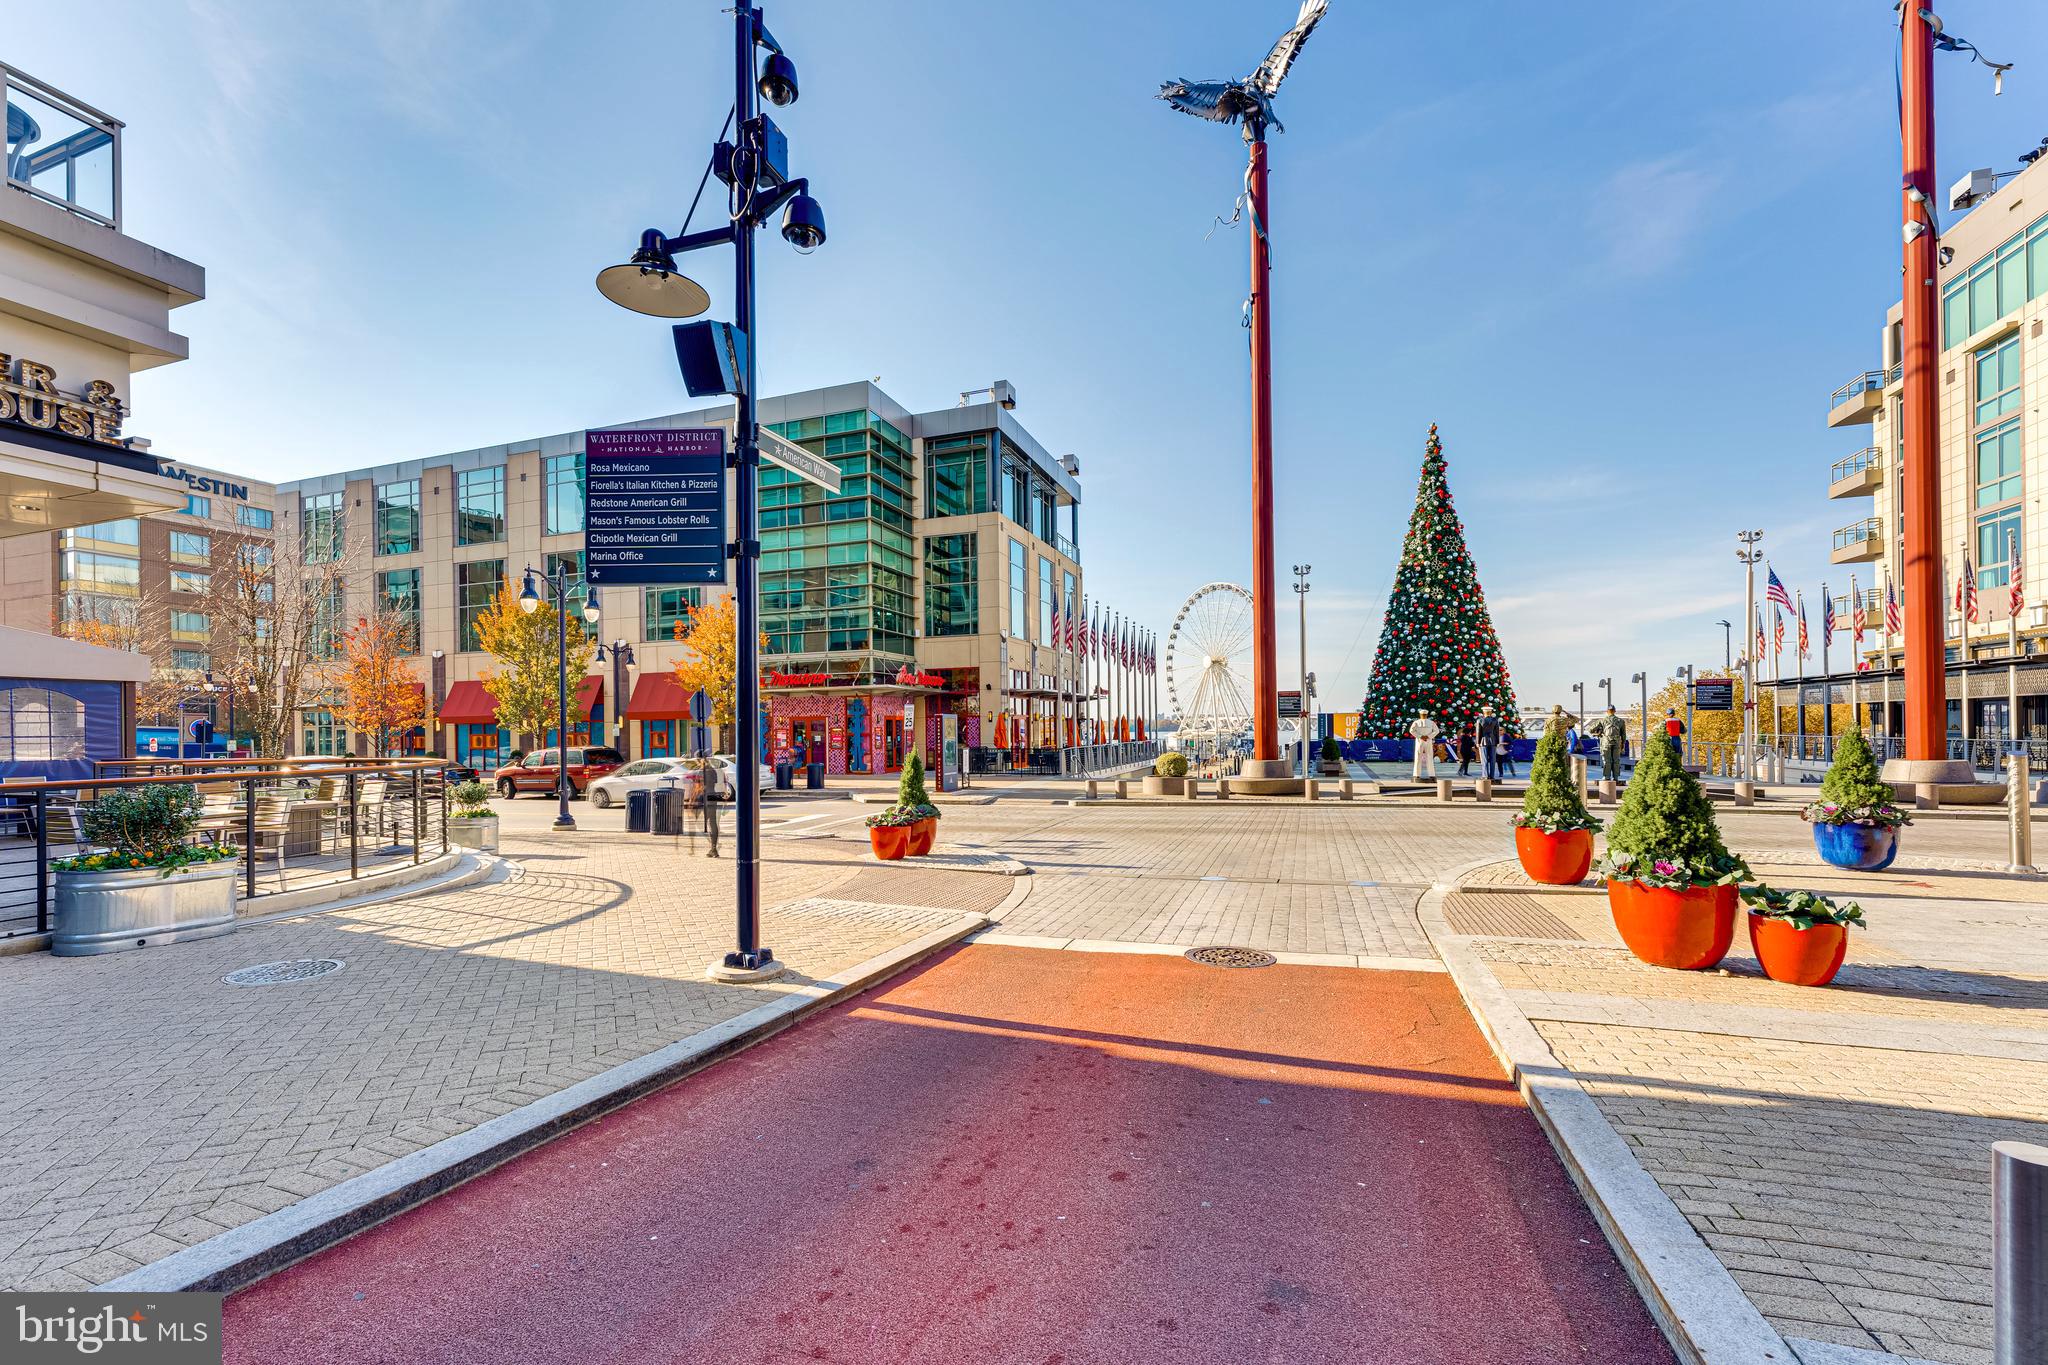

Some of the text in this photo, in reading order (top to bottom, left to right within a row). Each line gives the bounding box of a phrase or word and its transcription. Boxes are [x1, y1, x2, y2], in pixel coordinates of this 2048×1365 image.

[590, 432, 718, 444] WATERFRONT DISTRICT
[590, 463, 650, 472] Rosa Mexicano
[782, 446, 827, 481] American Way
[157, 464, 248, 500] WESTIN
[590, 479, 718, 490] Fiorella's Italian Kitchen & Pizzeria
[590, 497, 687, 508] Redstone American Grill
[624, 516, 656, 525] Famous
[657, 515, 688, 525] Lobster
[690, 515, 710, 524] Rolls
[590, 533, 678, 544] Chipotle Mexican Grill
[590, 551, 644, 561] Marina Office
